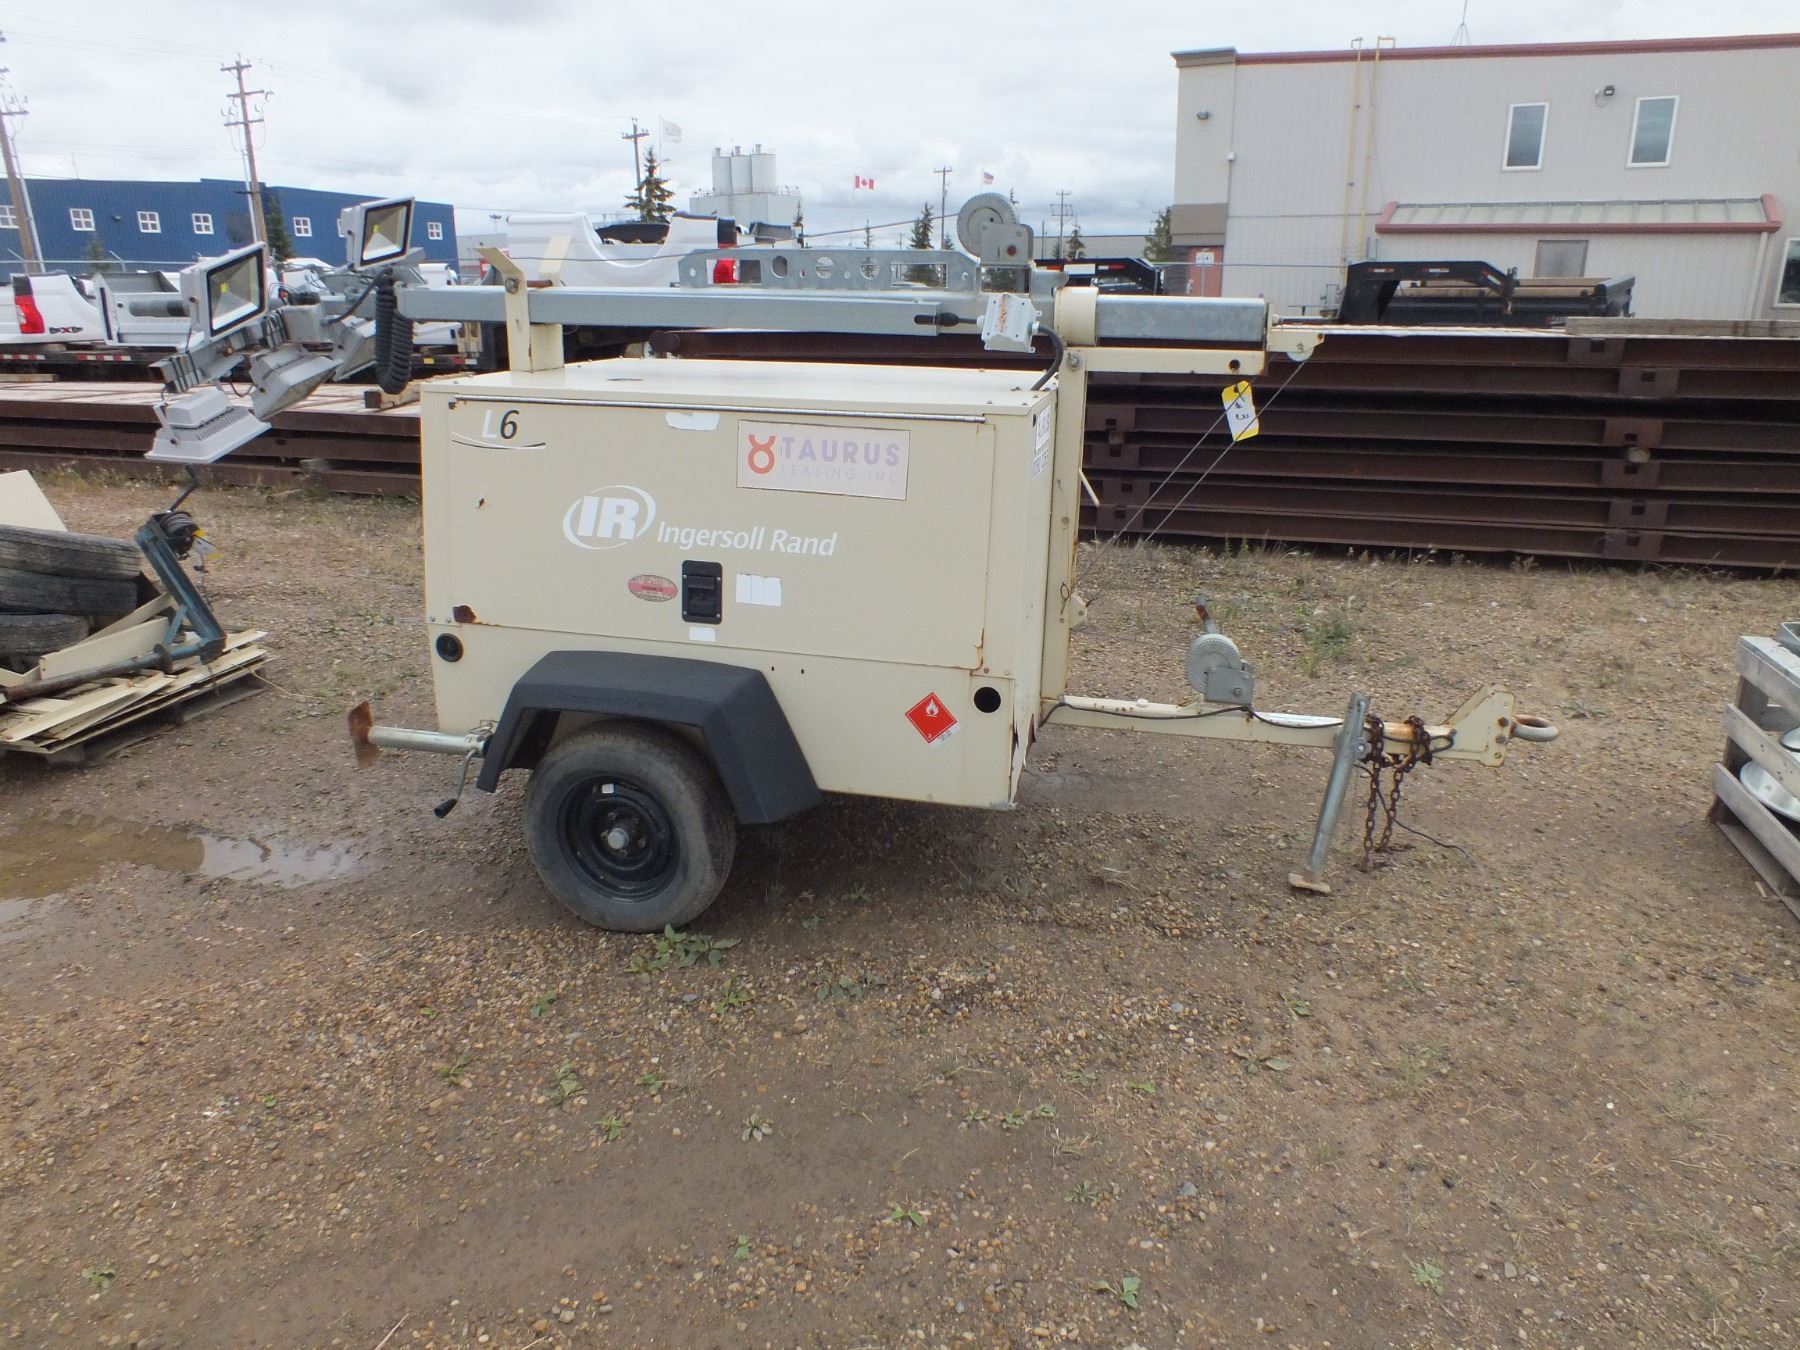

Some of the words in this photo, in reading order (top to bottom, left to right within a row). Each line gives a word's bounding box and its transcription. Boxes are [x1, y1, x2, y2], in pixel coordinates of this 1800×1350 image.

[481, 409, 520, 439] L6
[782, 437, 900, 466] TAURUS
[782, 465, 856, 480] LEASING
[577, 496, 639, 540] IR
[657, 521, 766, 551] Ingersoll
[769, 529, 838, 557] Rand
